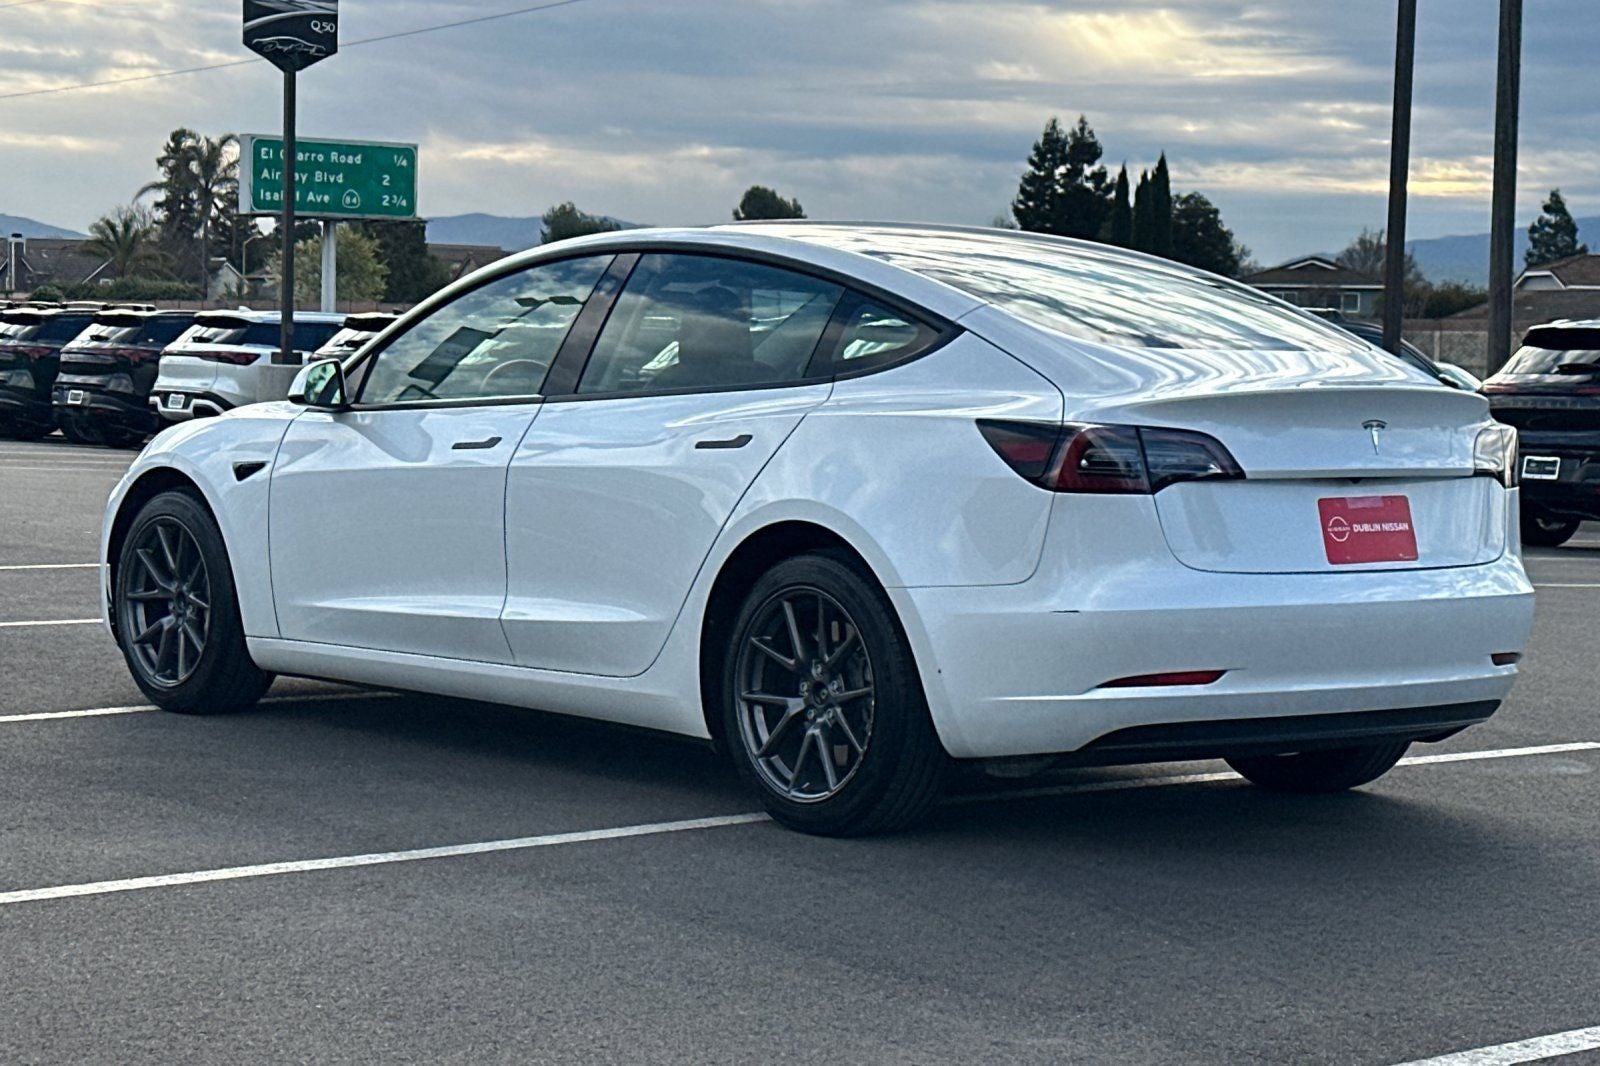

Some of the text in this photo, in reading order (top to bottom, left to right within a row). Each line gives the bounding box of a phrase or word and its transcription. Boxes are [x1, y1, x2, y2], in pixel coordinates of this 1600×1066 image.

[310, 20, 336, 34] Q50
[261, 147, 273, 159] El
[280, 149, 324, 162] arro
[330, 151, 362, 164] Road
[261, 168, 391, 186] Airay Blvd 2
[260, 188, 300, 202] Isal
[306, 191, 330, 203] Ave
[1352, 523, 1381, 533] DUBLIN
[1381, 522, 1409, 532] NISSAN
